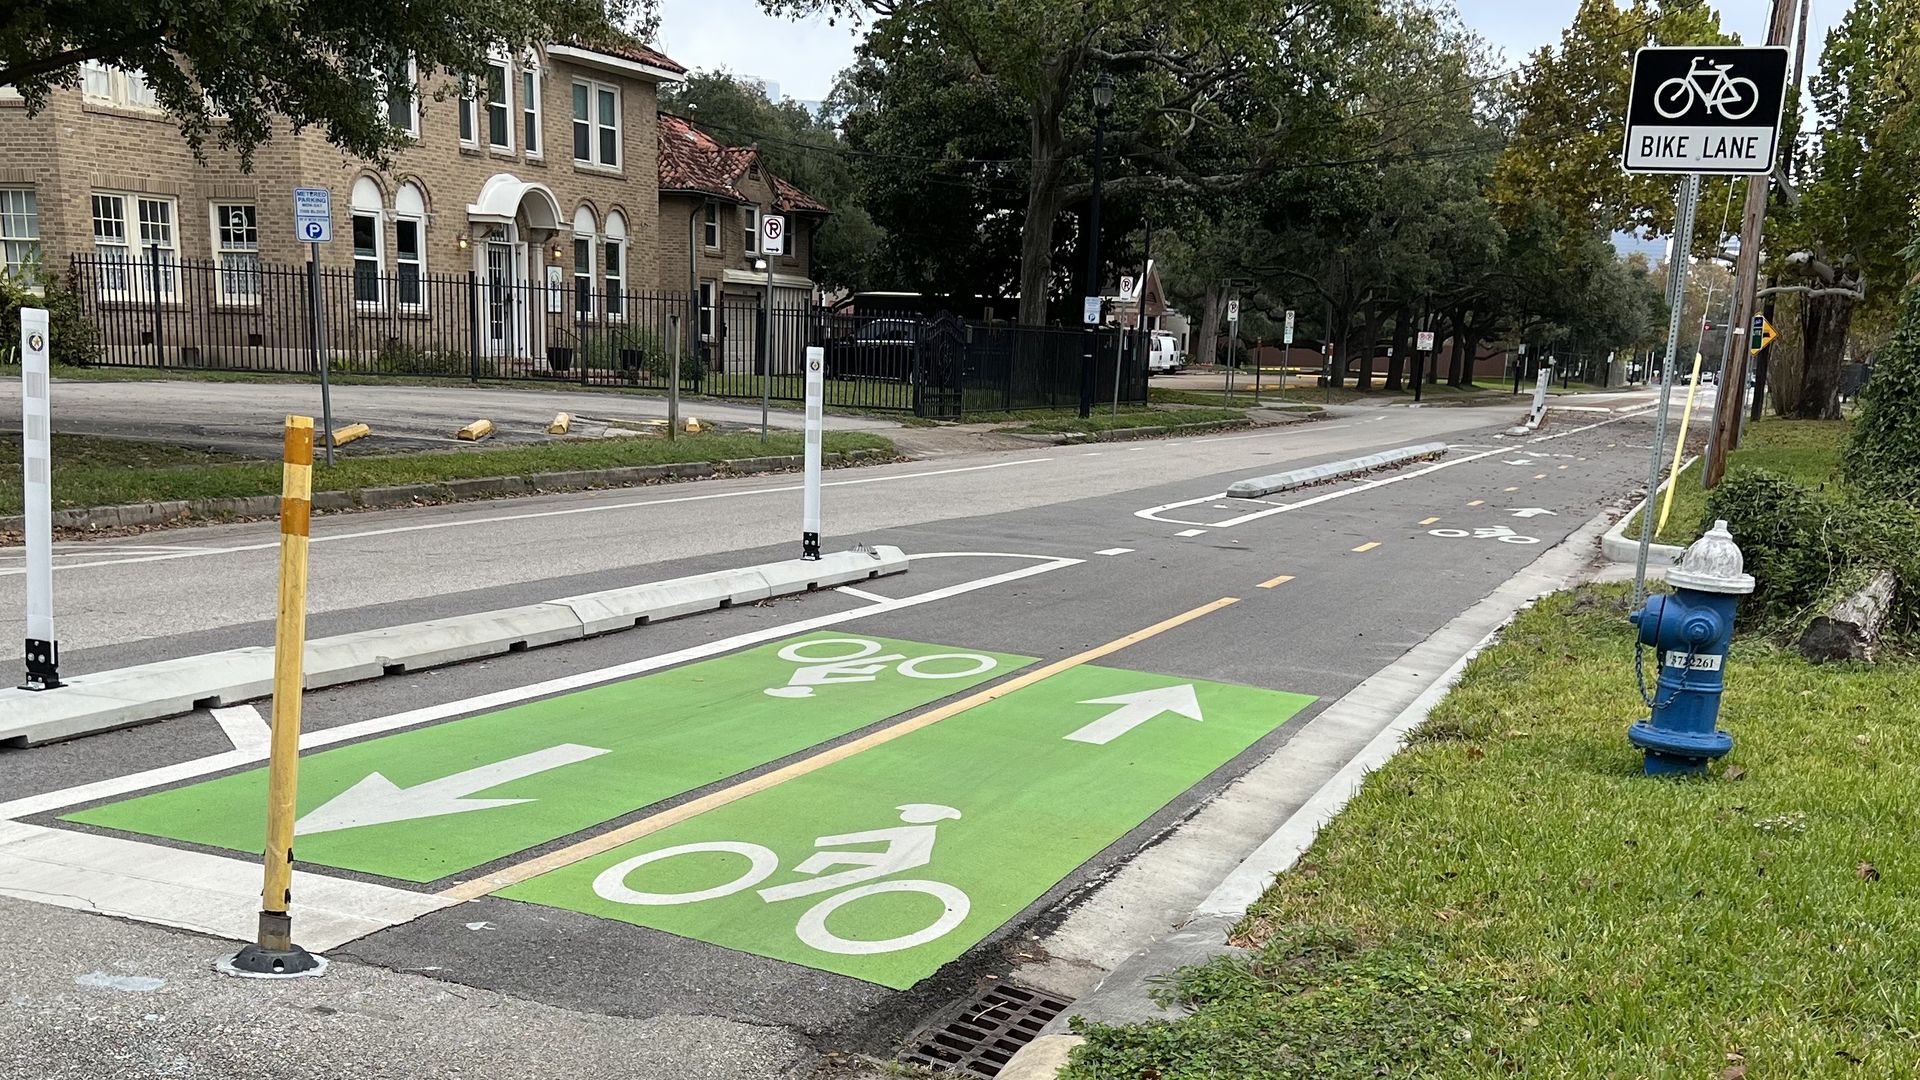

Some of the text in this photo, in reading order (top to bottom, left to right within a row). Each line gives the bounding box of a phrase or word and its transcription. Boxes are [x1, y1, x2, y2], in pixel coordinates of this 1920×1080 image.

[1640, 136, 1759, 159] BIKE LANE
[309, 224, 320, 237] P
